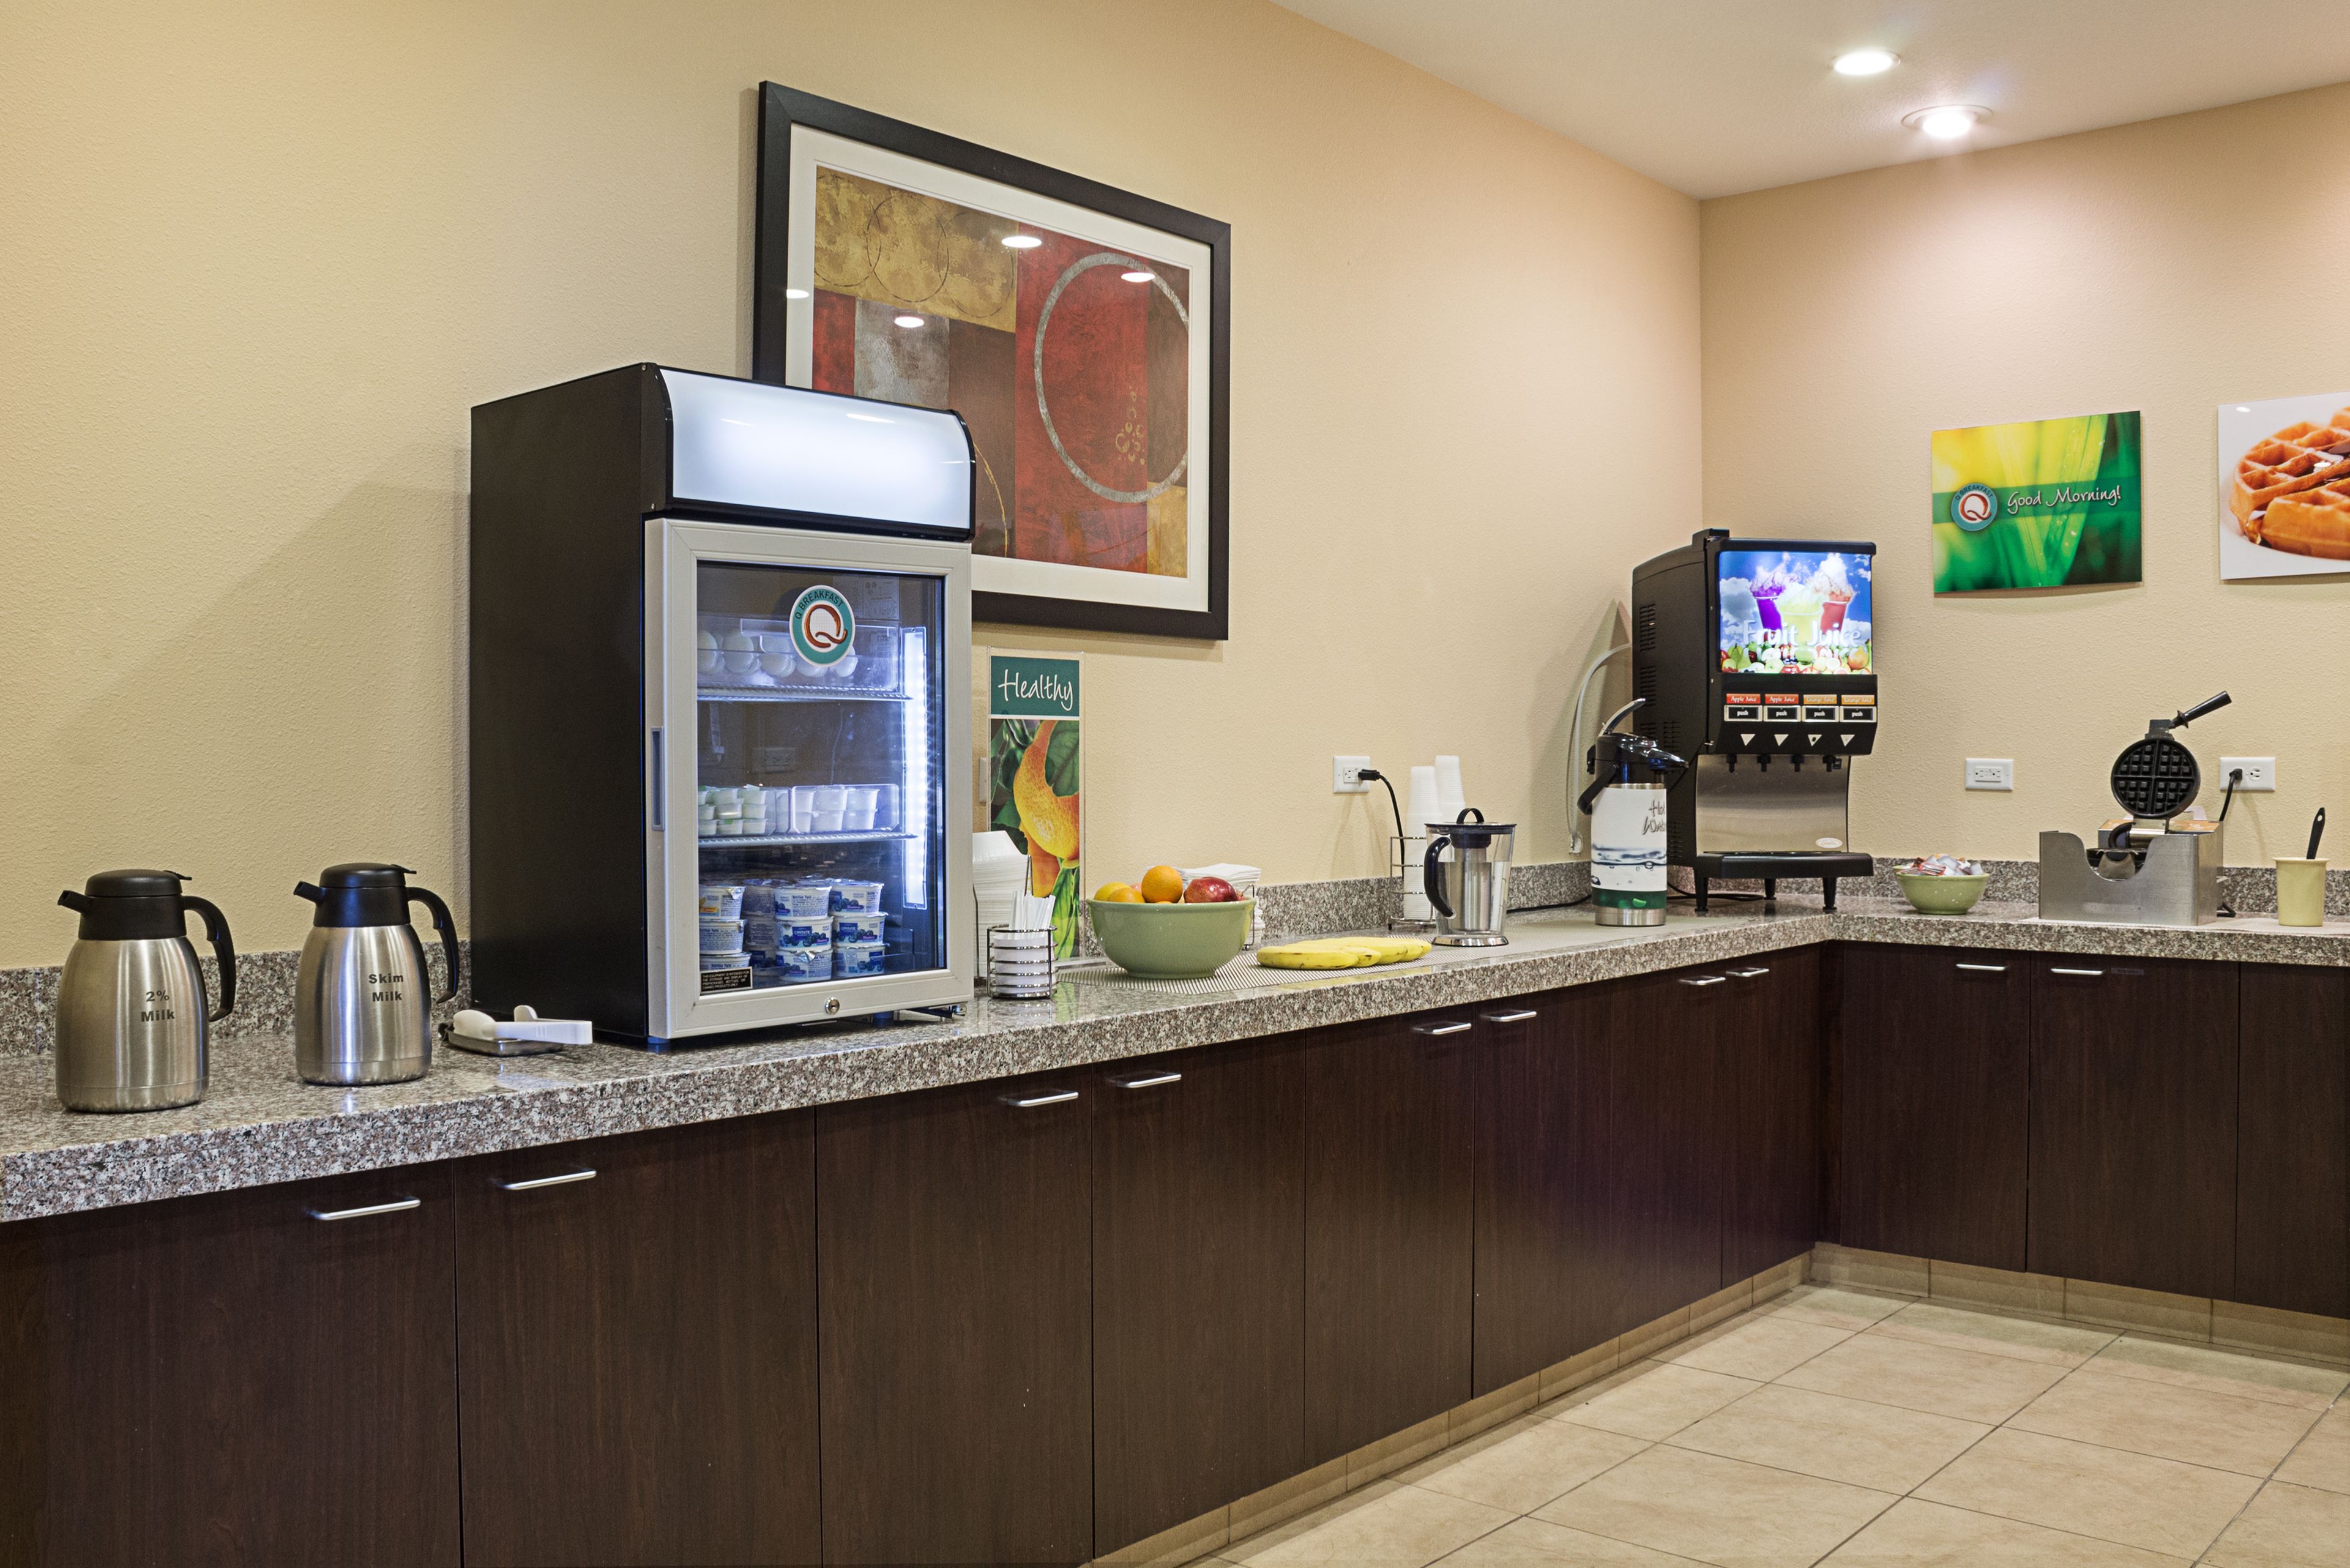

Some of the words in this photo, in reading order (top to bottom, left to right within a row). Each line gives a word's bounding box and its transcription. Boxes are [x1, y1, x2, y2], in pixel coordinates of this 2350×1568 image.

[1959, 485, 1993, 498] BREAKFAST
[2007, 491, 2042, 515] Good
[2045, 485, 2121, 507] Morning!
[799, 591, 844, 610] BREAKFAST
[1744, 619, 1798, 646] Fruit
[1806, 620, 1862, 648] Juice
[998, 668, 1073, 711] Healthy
[368, 973, 404, 984] Skim
[146, 990, 170, 1002] 2%
[372, 991, 402, 1002] Milk
[141, 1009, 175, 1022] Milk
